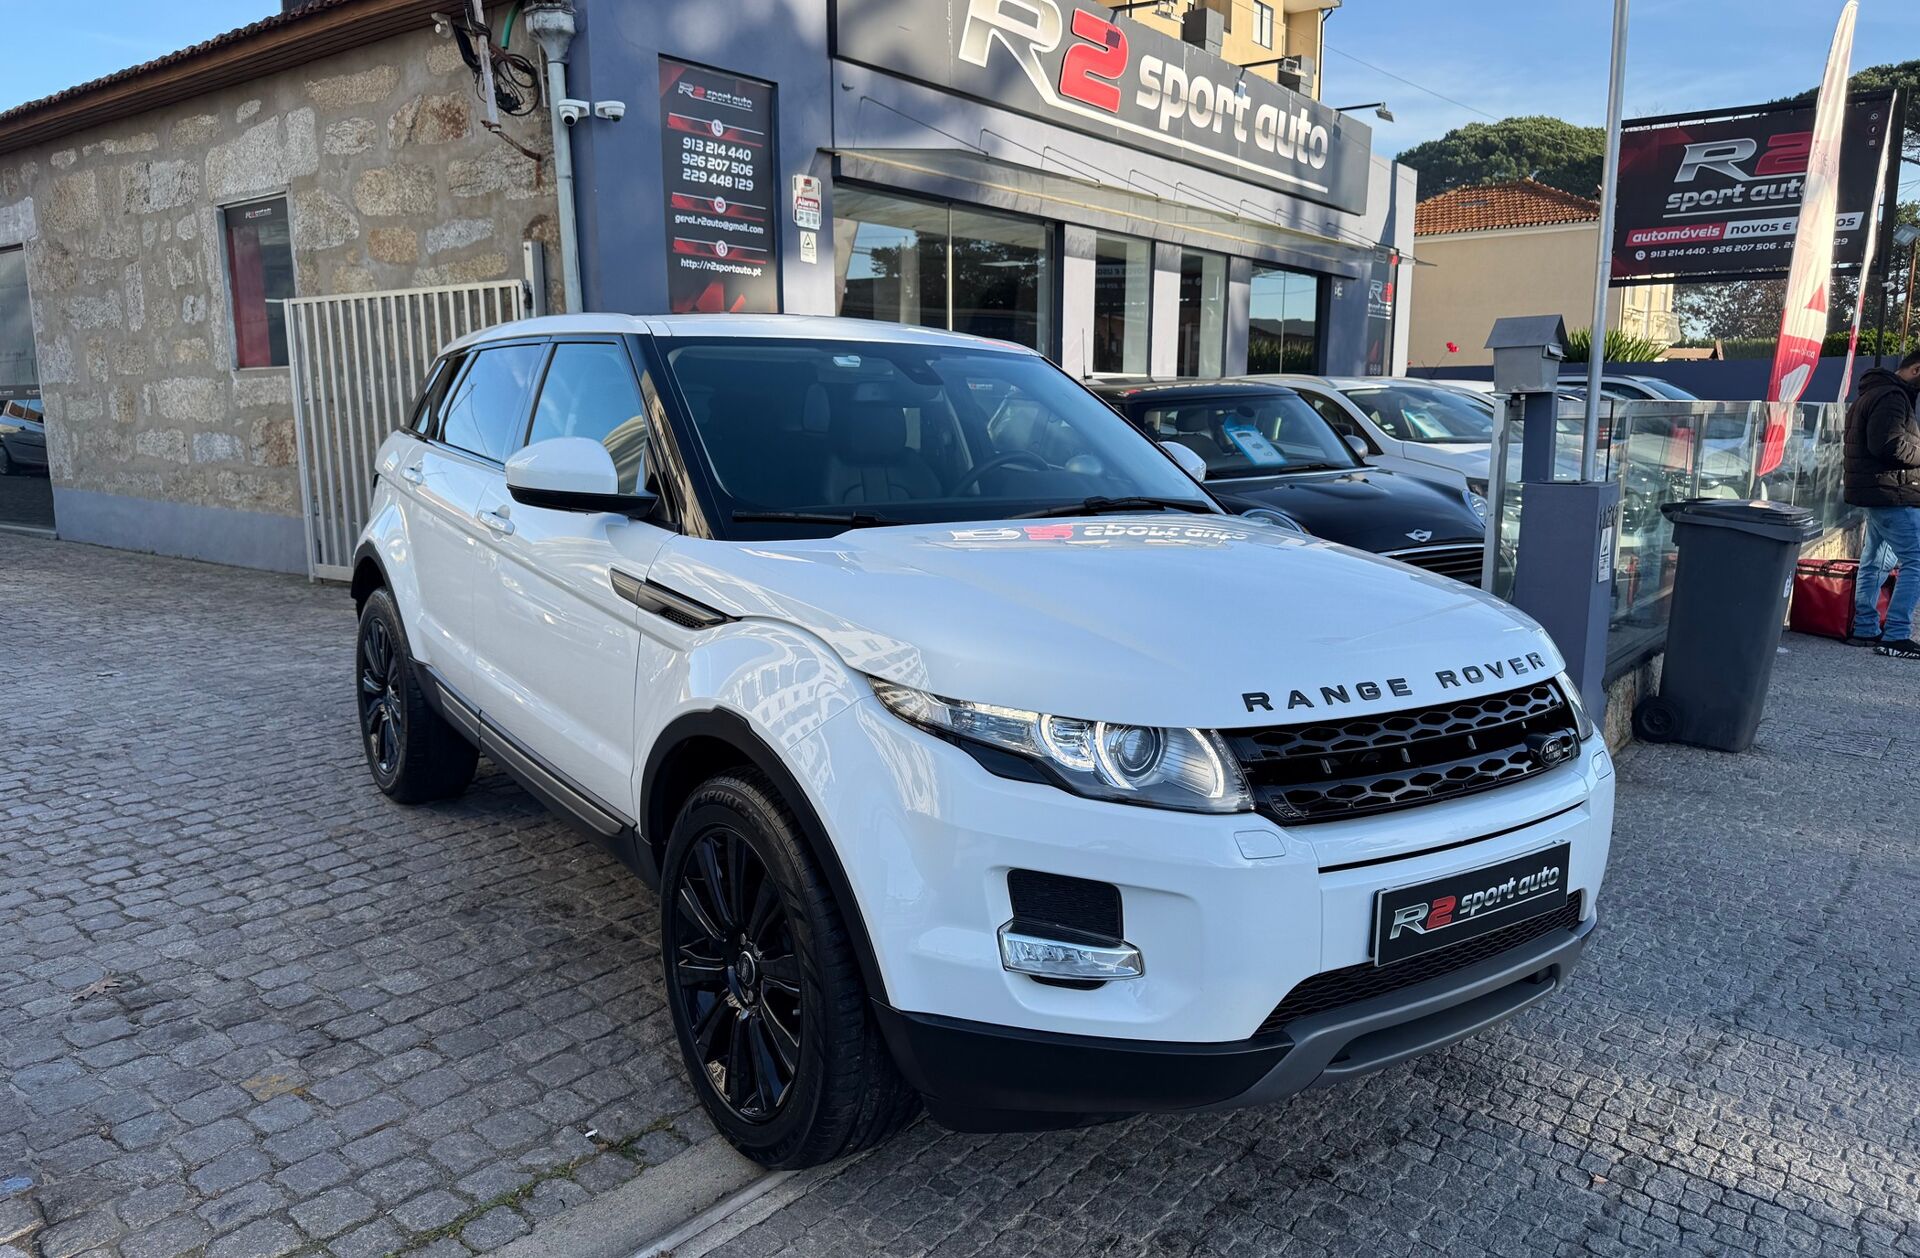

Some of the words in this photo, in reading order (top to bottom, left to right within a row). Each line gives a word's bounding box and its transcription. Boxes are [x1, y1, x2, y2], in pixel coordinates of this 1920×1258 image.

[678, 82, 705, 98] R2
[706, 90, 732, 102] sport
[732, 96, 753, 108] auto
[958, 0, 1129, 113] R2
[1136, 54, 1251, 143] sport
[1255, 102, 1329, 170] auto
[682, 136, 704, 152] 913
[706, 141, 726, 157] 214
[727, 146, 752, 161] 440
[1674, 131, 1812, 183] R2
[681, 152, 706, 168] 926
[707, 156, 730, 172] 207
[730, 161, 753, 177] 506
[682, 168, 708, 183] 229
[708, 173, 733, 188] 448
[734, 177, 754, 192] 129
[1665, 183, 1745, 212] sport
[675, 214, 764, 234] geral.r2auto@gmail.com
[1632, 225, 1721, 243] automóveis
[1650, 250, 1667, 259] 913
[1668, 249, 1685, 257] 214
[1685, 247, 1706, 256] 440
[1712, 245, 1733, 254] 926
[1734, 243, 1753, 252] 207
[1755, 242, 1777, 251] 506
[680, 257, 762, 278] http://r2sportauto.pt
[1242, 677, 1413, 713] RANGE
[1435, 651, 1546, 689] ROVER
[1389, 895, 1457, 940] R2
[1459, 877, 1516, 916] sport
[1517, 866, 1560, 895] auto
